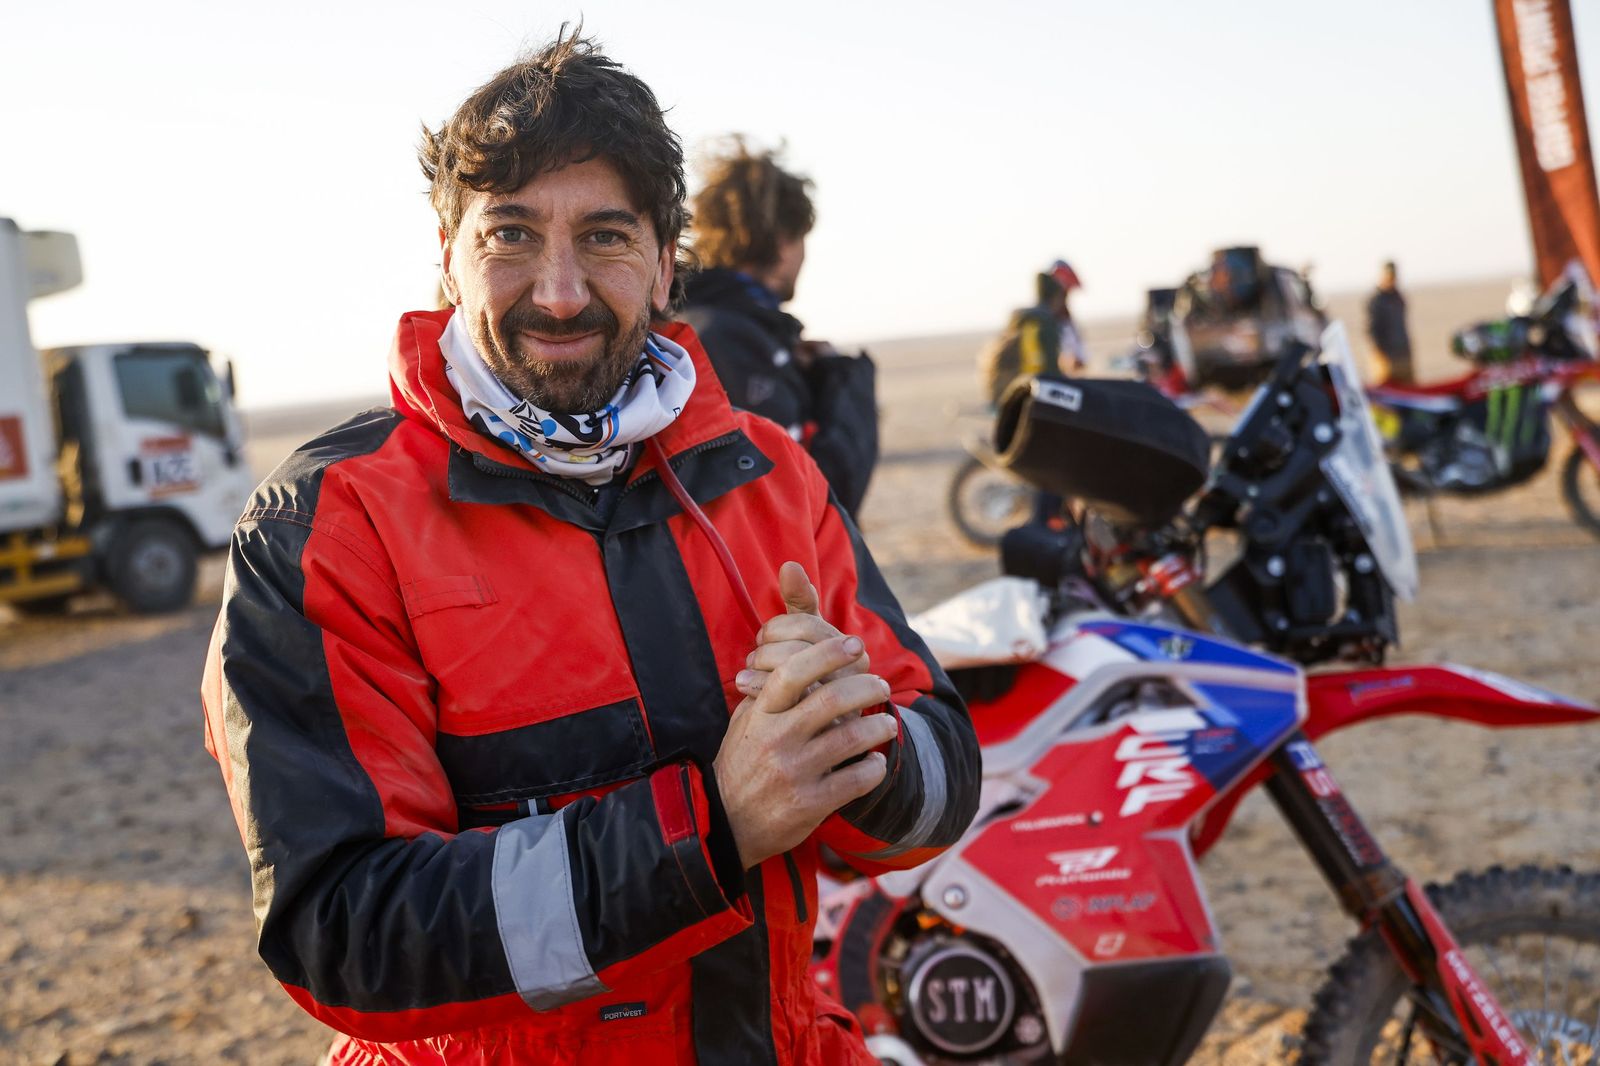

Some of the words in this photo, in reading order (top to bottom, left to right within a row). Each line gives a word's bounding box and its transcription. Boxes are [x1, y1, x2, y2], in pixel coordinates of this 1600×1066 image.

[604, 1009, 643, 1020] PORTWEST
[927, 976, 998, 1024] STM
[1445, 951, 1521, 1057] METZELER
